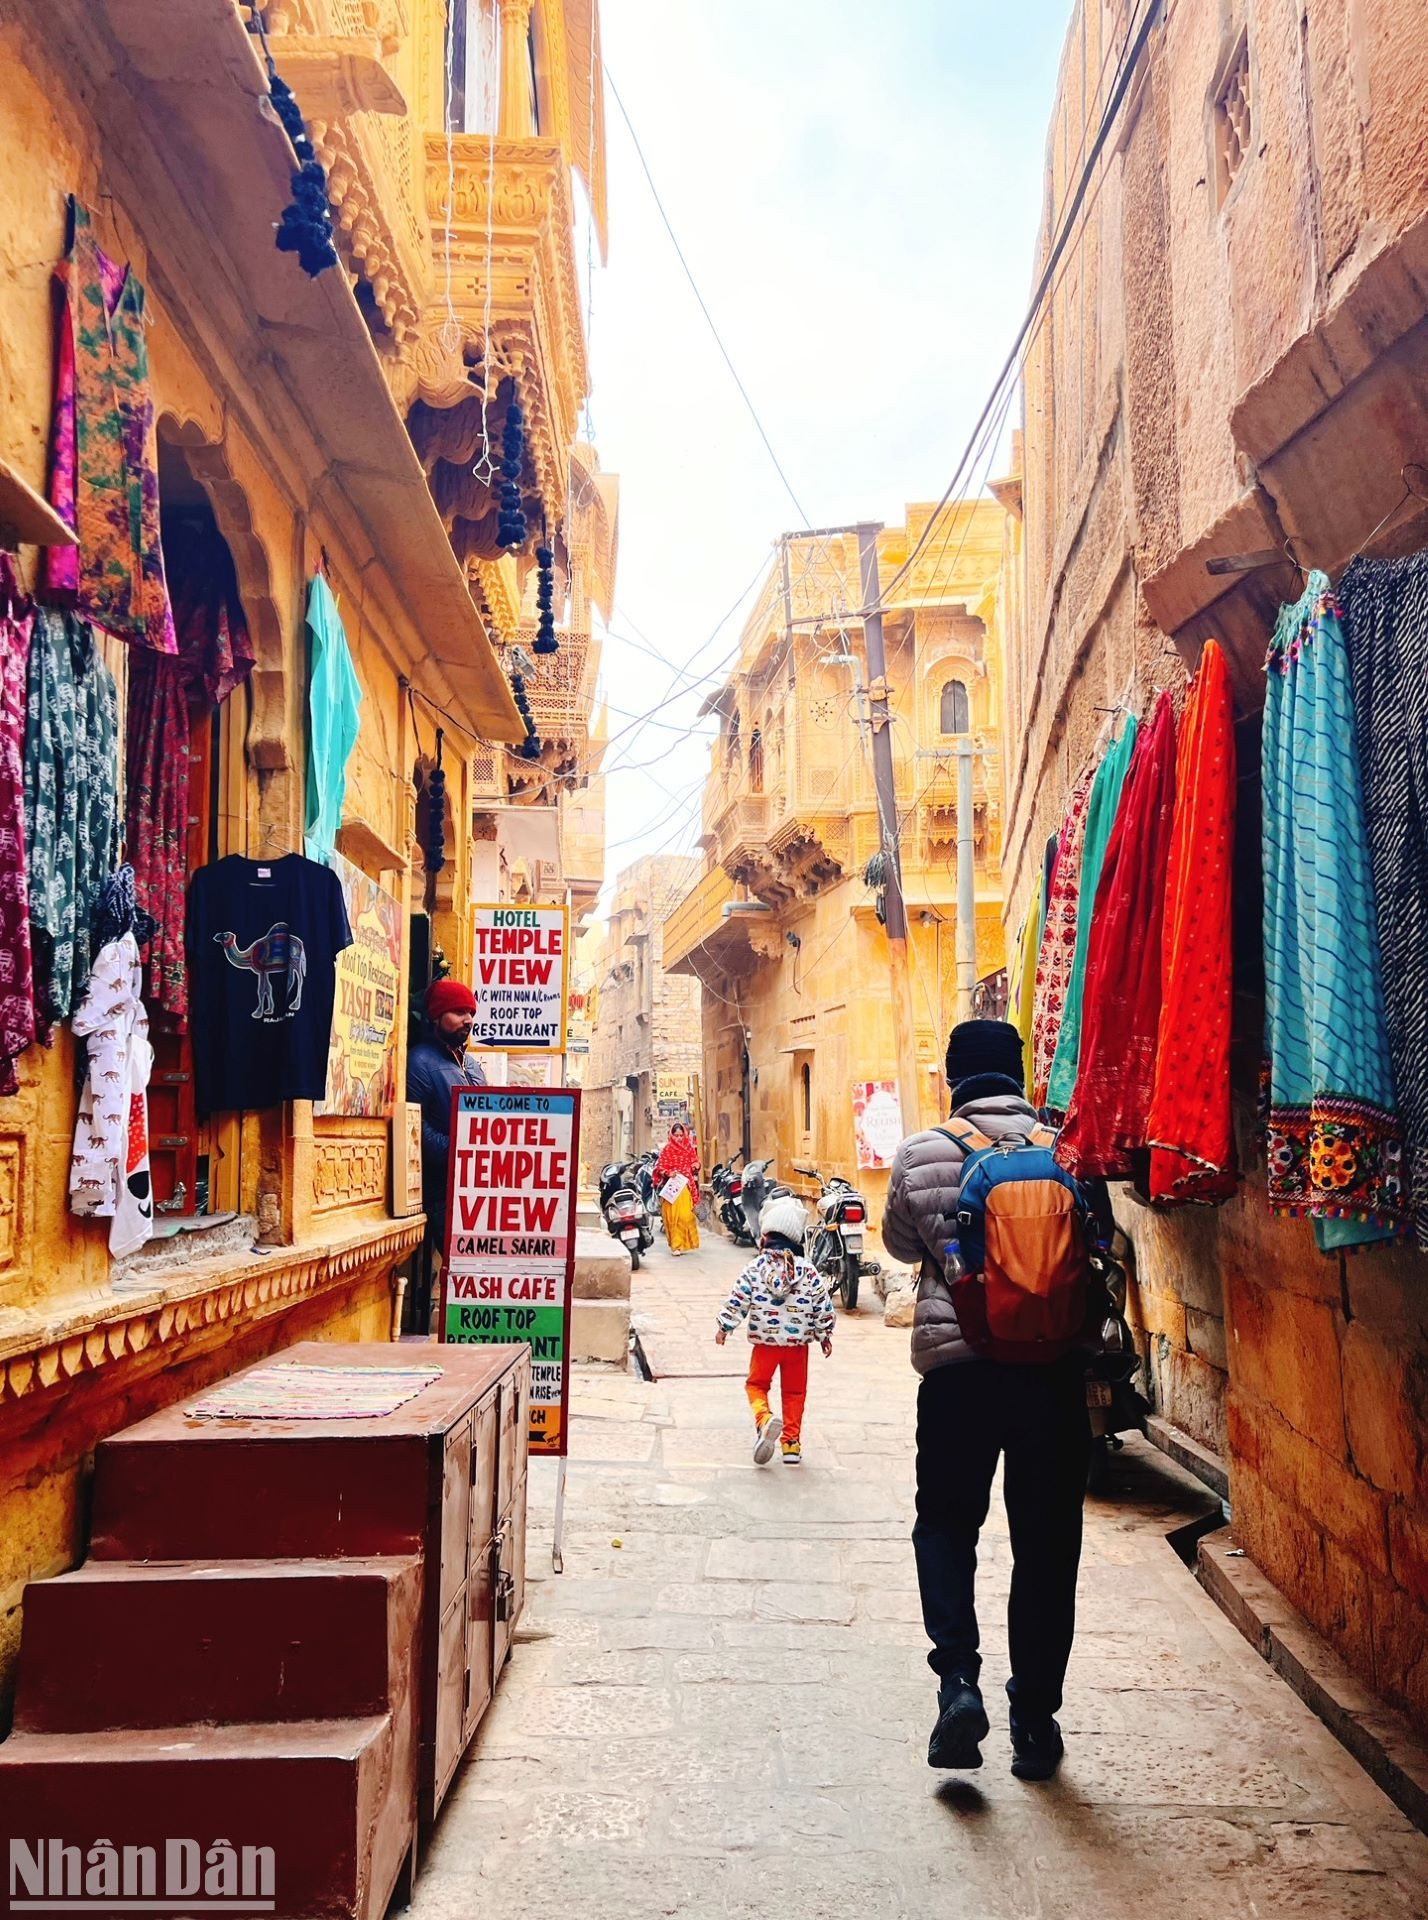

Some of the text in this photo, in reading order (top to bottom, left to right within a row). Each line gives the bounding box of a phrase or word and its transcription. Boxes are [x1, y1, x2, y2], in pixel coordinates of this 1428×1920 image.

[493, 910, 540, 927] HOTEL
[475, 928, 561, 955] TEMPLE
[478, 959, 553, 985] VIEW
[340, 978, 372, 1022] YASH
[490, 989, 512, 1002] WITH
[513, 990, 532, 1002] NON
[490, 1007, 542, 1020] ROOF TOP
[472, 1023, 558, 1037] RESTAURANT
[535, 1097, 549, 1111] TO
[469, 1117, 556, 1146] HOTEL
[457, 1150, 566, 1190] TEMPLE
[458, 1195, 559, 1232] VIEW
[457, 1237, 556, 1256] CAMEL SAFARI
[451, 1276, 503, 1299] YASH
[460, 1307, 537, 1330] ROOF TOP
[531, 1366, 561, 1382] TEMPLE
[535, 1386, 551, 1400] RISE
[529, 1410, 546, 1424] CH
